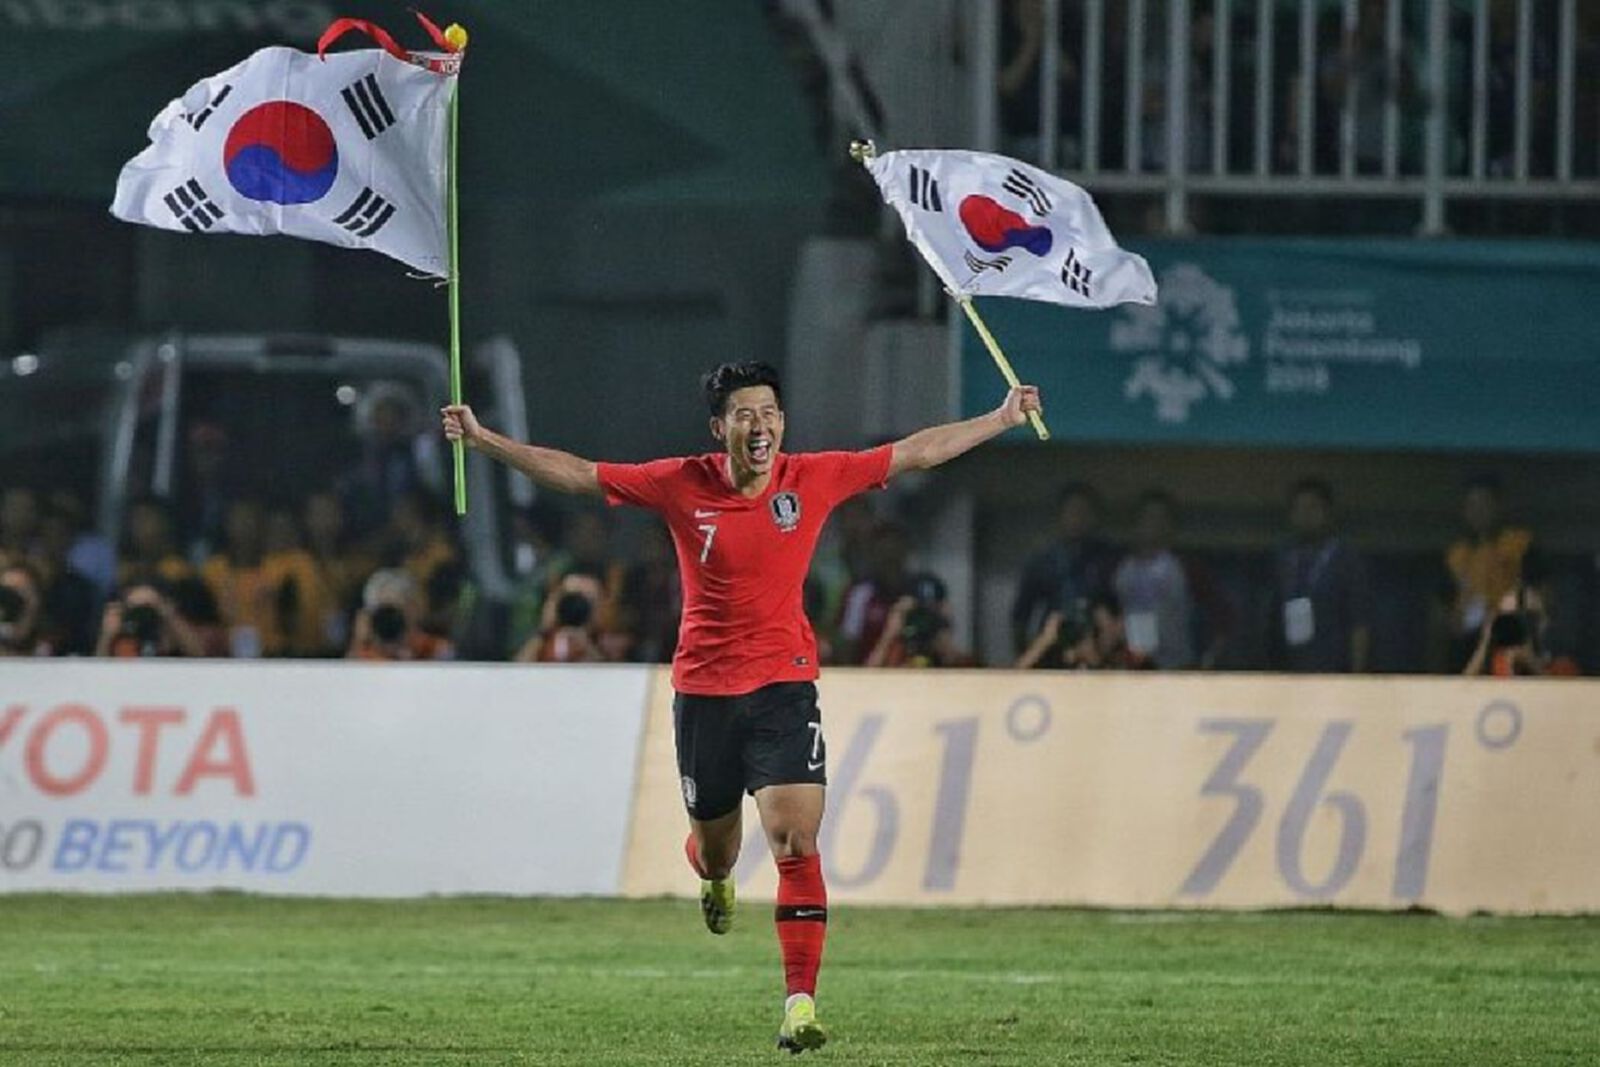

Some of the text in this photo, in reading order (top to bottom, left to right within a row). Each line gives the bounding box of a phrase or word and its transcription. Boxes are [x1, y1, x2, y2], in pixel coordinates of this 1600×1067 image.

[698, 524, 717, 563] 7
[808, 722, 821, 760] 7
[739, 695, 1051, 892] 61°
[0, 818, 312, 874] O BEYOND
